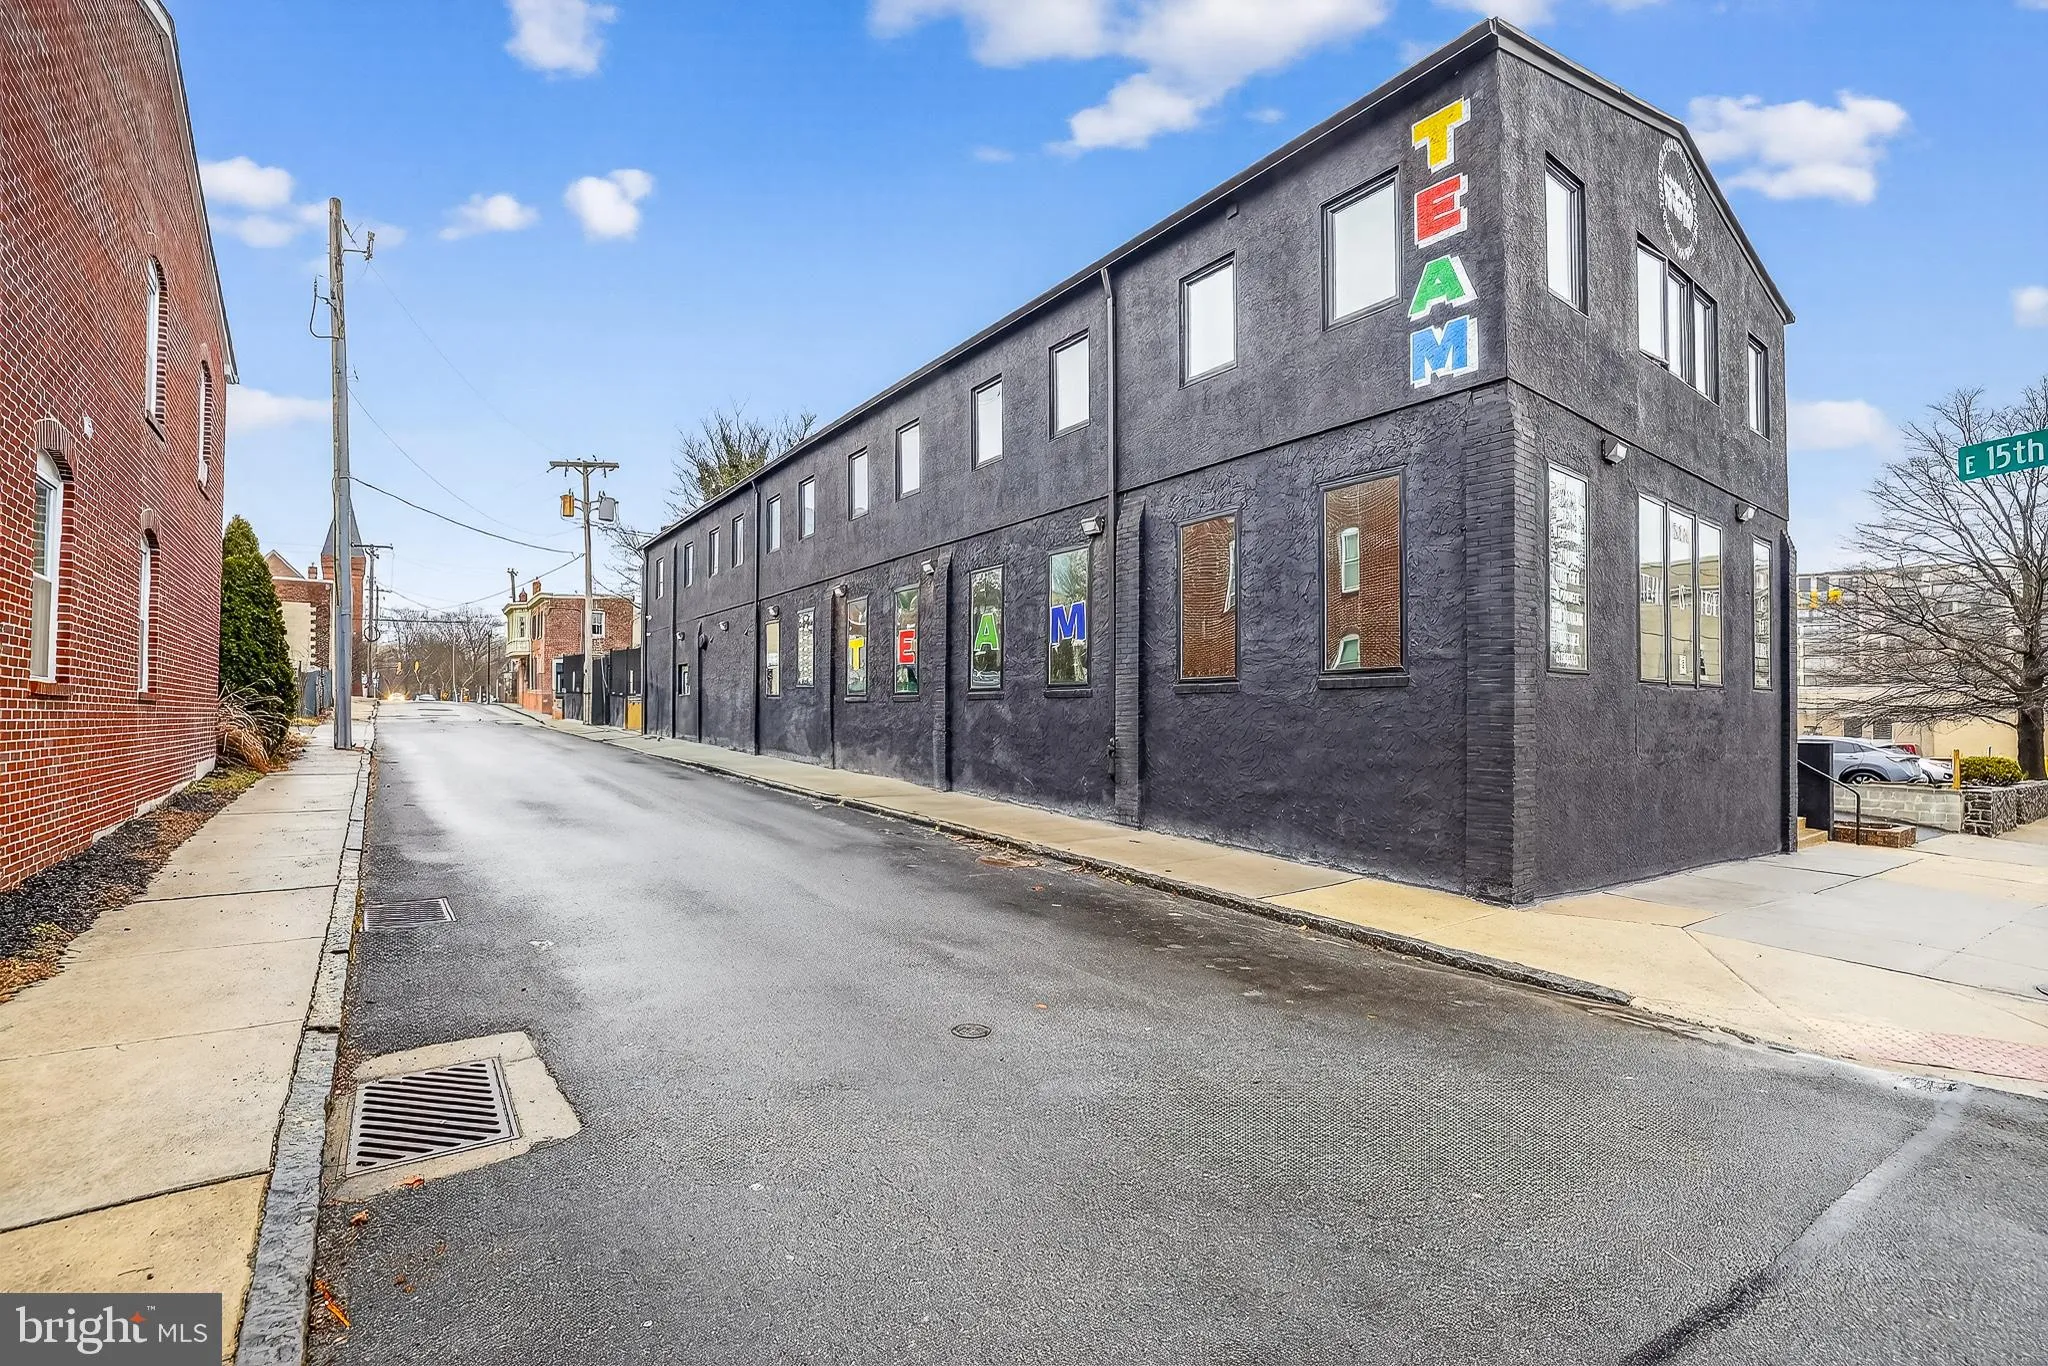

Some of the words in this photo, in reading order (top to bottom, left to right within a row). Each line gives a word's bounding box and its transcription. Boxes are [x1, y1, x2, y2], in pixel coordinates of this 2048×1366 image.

[1408, 96, 1478, 388] TEAM
[1965, 456, 1976, 475] E
[1986, 438, 2045, 470] 15th
